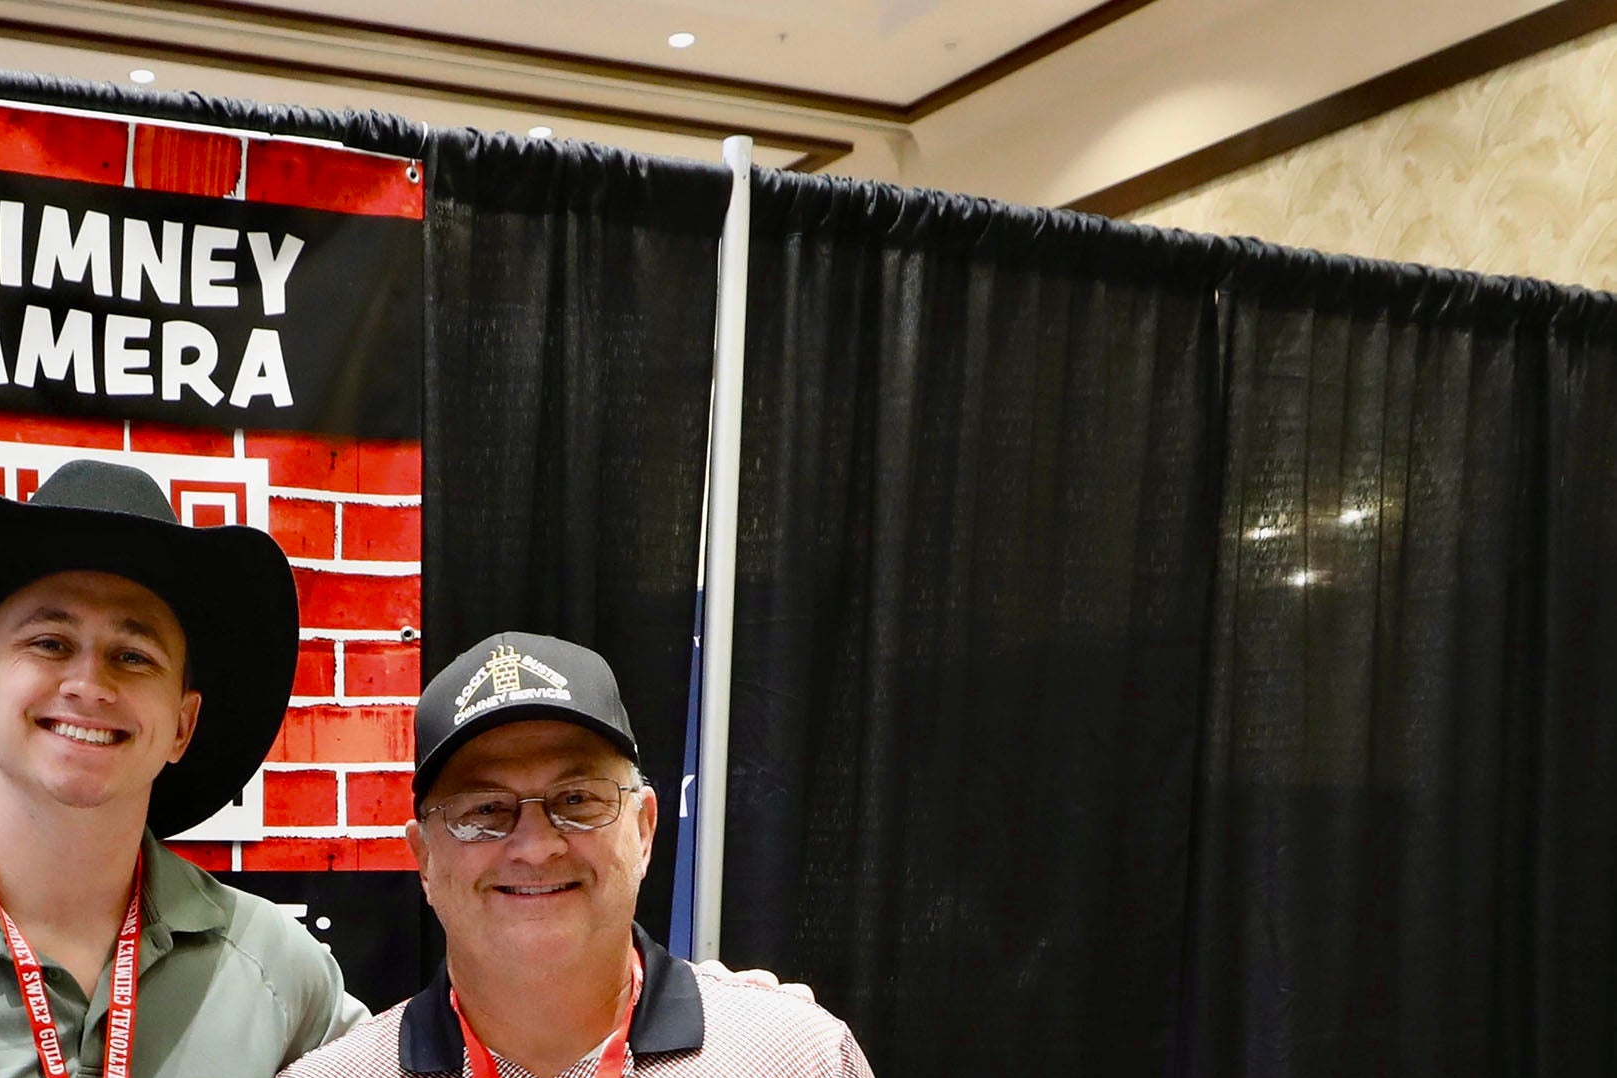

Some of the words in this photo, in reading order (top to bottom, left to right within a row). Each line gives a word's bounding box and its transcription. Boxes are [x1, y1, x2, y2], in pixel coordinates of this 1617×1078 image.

[454, 692, 507, 726] CHIMNEY
[114, 938, 135, 1004] CHIMNEY
[22, 971, 52, 1025] SWEEP
[39, 1027, 65, 1076] GUILD
